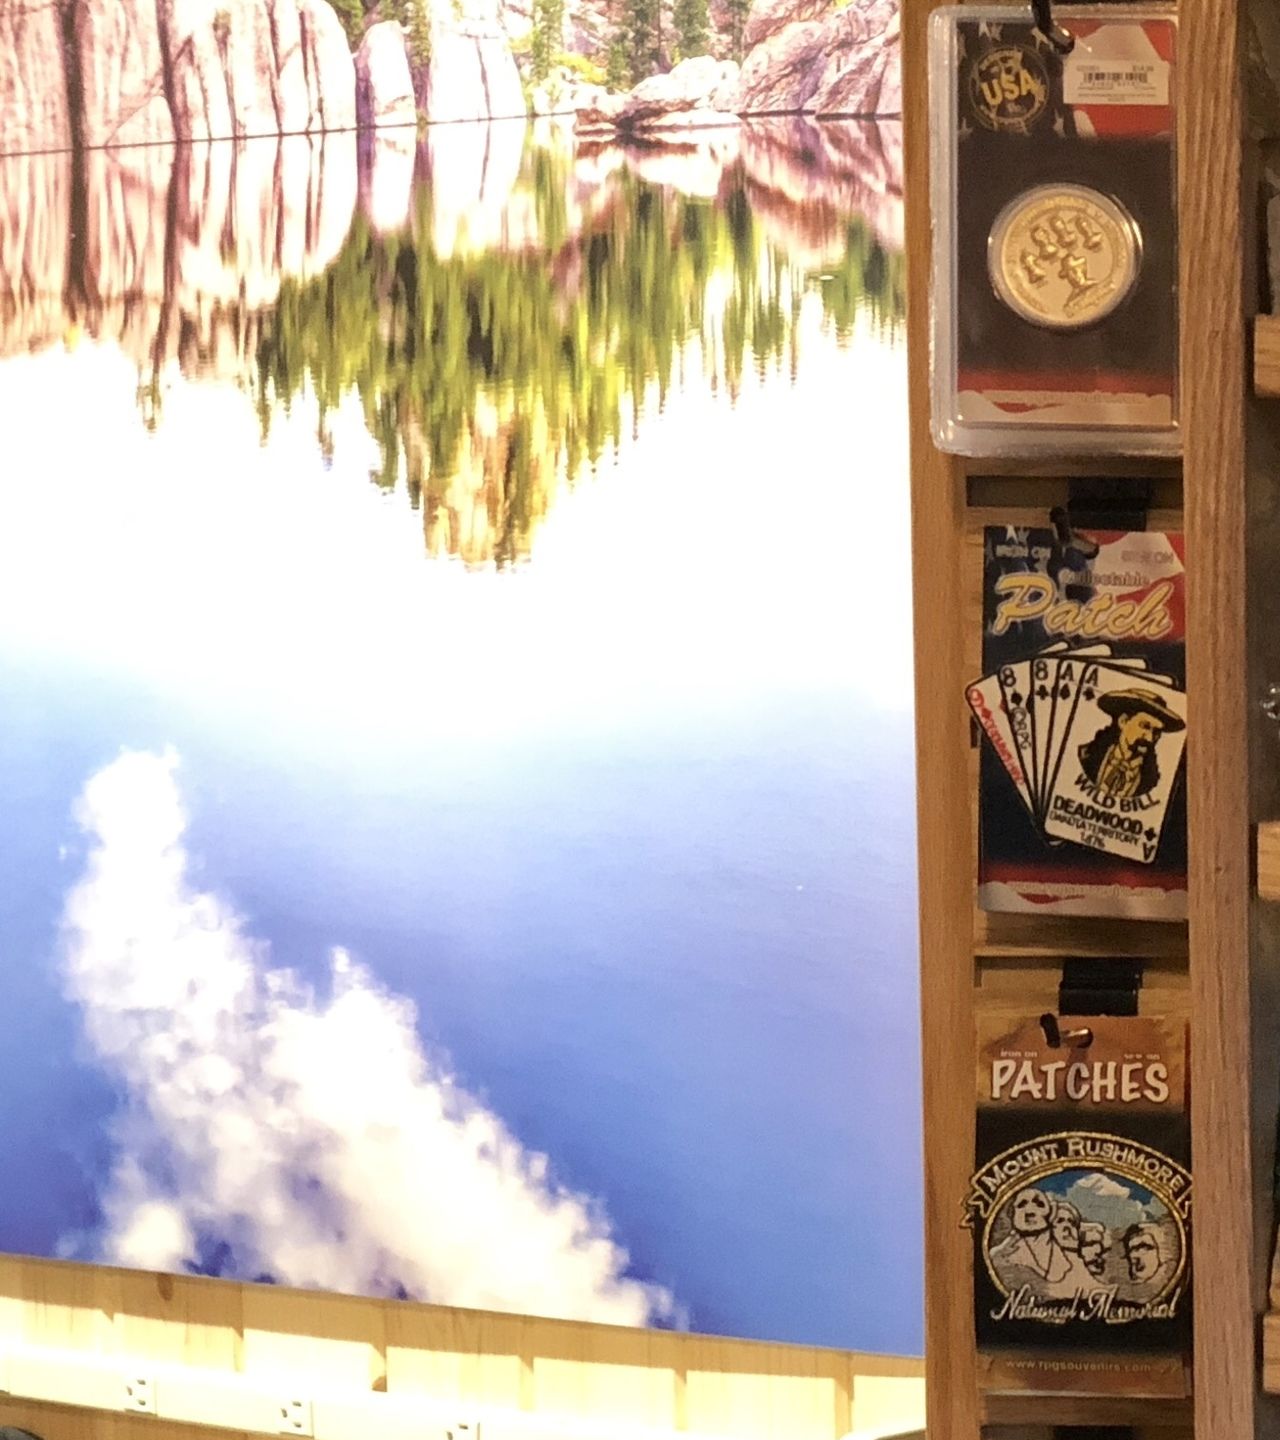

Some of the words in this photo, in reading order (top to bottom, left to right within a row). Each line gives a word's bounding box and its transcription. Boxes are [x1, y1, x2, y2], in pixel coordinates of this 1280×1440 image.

[981, 68, 1036, 105] USA
[993, 571, 1175, 640] Patch
[1001, 667, 1017, 687] 8
[1035, 660, 1048, 681] 8
[1060, 662, 1075, 682] A
[1086, 667, 1100, 688] A
[1074, 773, 1115, 810] WILD
[1119, 793, 1160, 813] BILL
[1053, 795, 1142, 835] DEADWOOD
[992, 1059, 1170, 1102] PATCHES
[985, 1142, 1061, 1193] MOUNT
[1067, 1136, 1185, 1192] RUSHMORE
[991, 1284, 1078, 1321] National
[1079, 1287, 1180, 1321] Memorial
